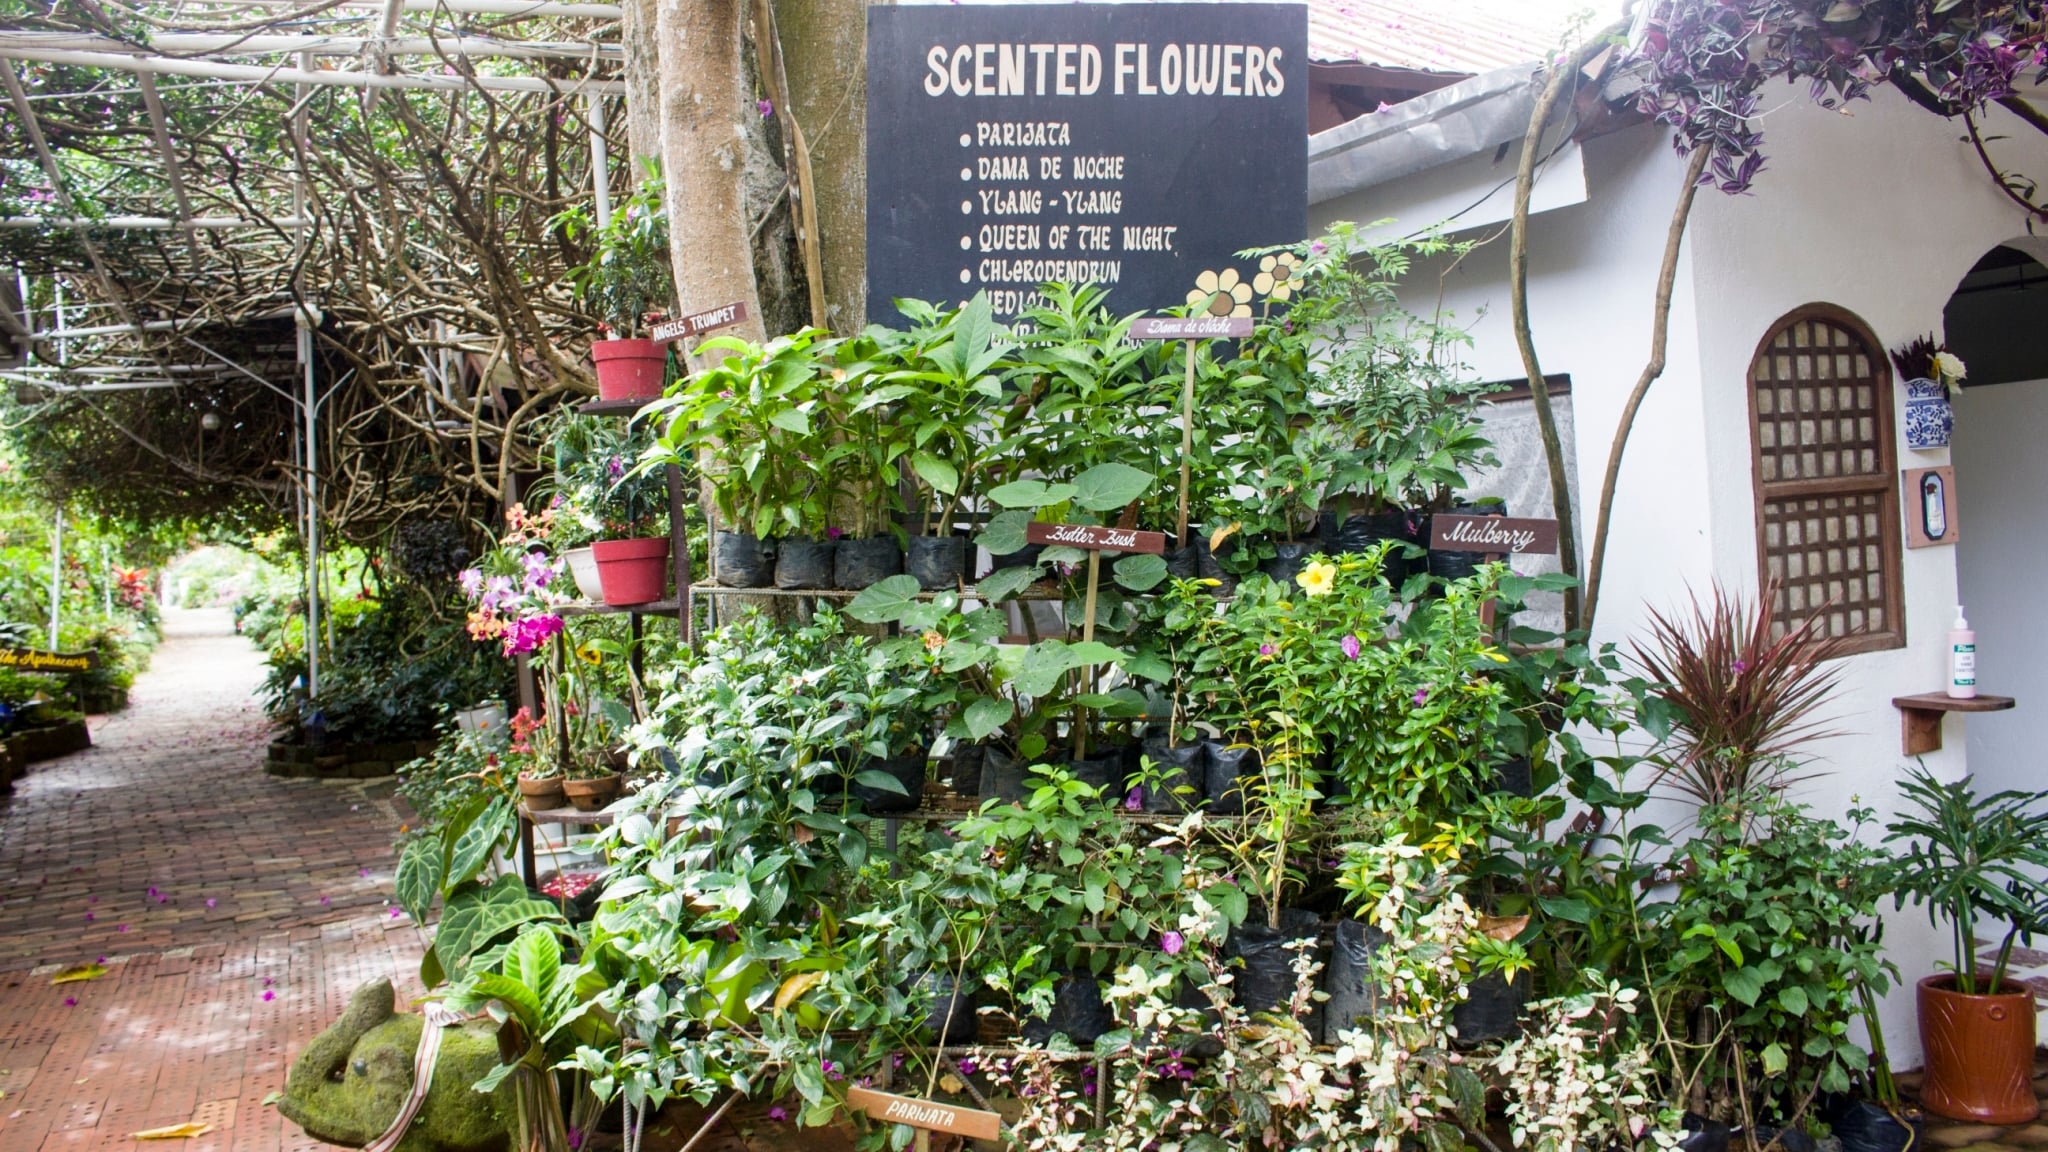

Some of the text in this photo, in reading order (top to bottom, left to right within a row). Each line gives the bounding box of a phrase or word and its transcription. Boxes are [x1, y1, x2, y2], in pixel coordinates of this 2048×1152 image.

[924, 43, 1284, 96] SCENTED FLOWERS
[977, 122, 1070, 146] PARIJATA
[978, 157, 1124, 180] DAMA DE NOCHE
[980, 225, 1176, 252] QUEEN OF THE NIGHT
[653, 306, 735, 342] ANGELS TRUMPET
[1147, 320, 1181, 334] Dama
[1184, 318, 1197, 333] de
[1099, 529, 1138, 548] Bush
[1442, 519, 1536, 553] Mulberry
[885, 1100, 955, 1126] PARIJATA
